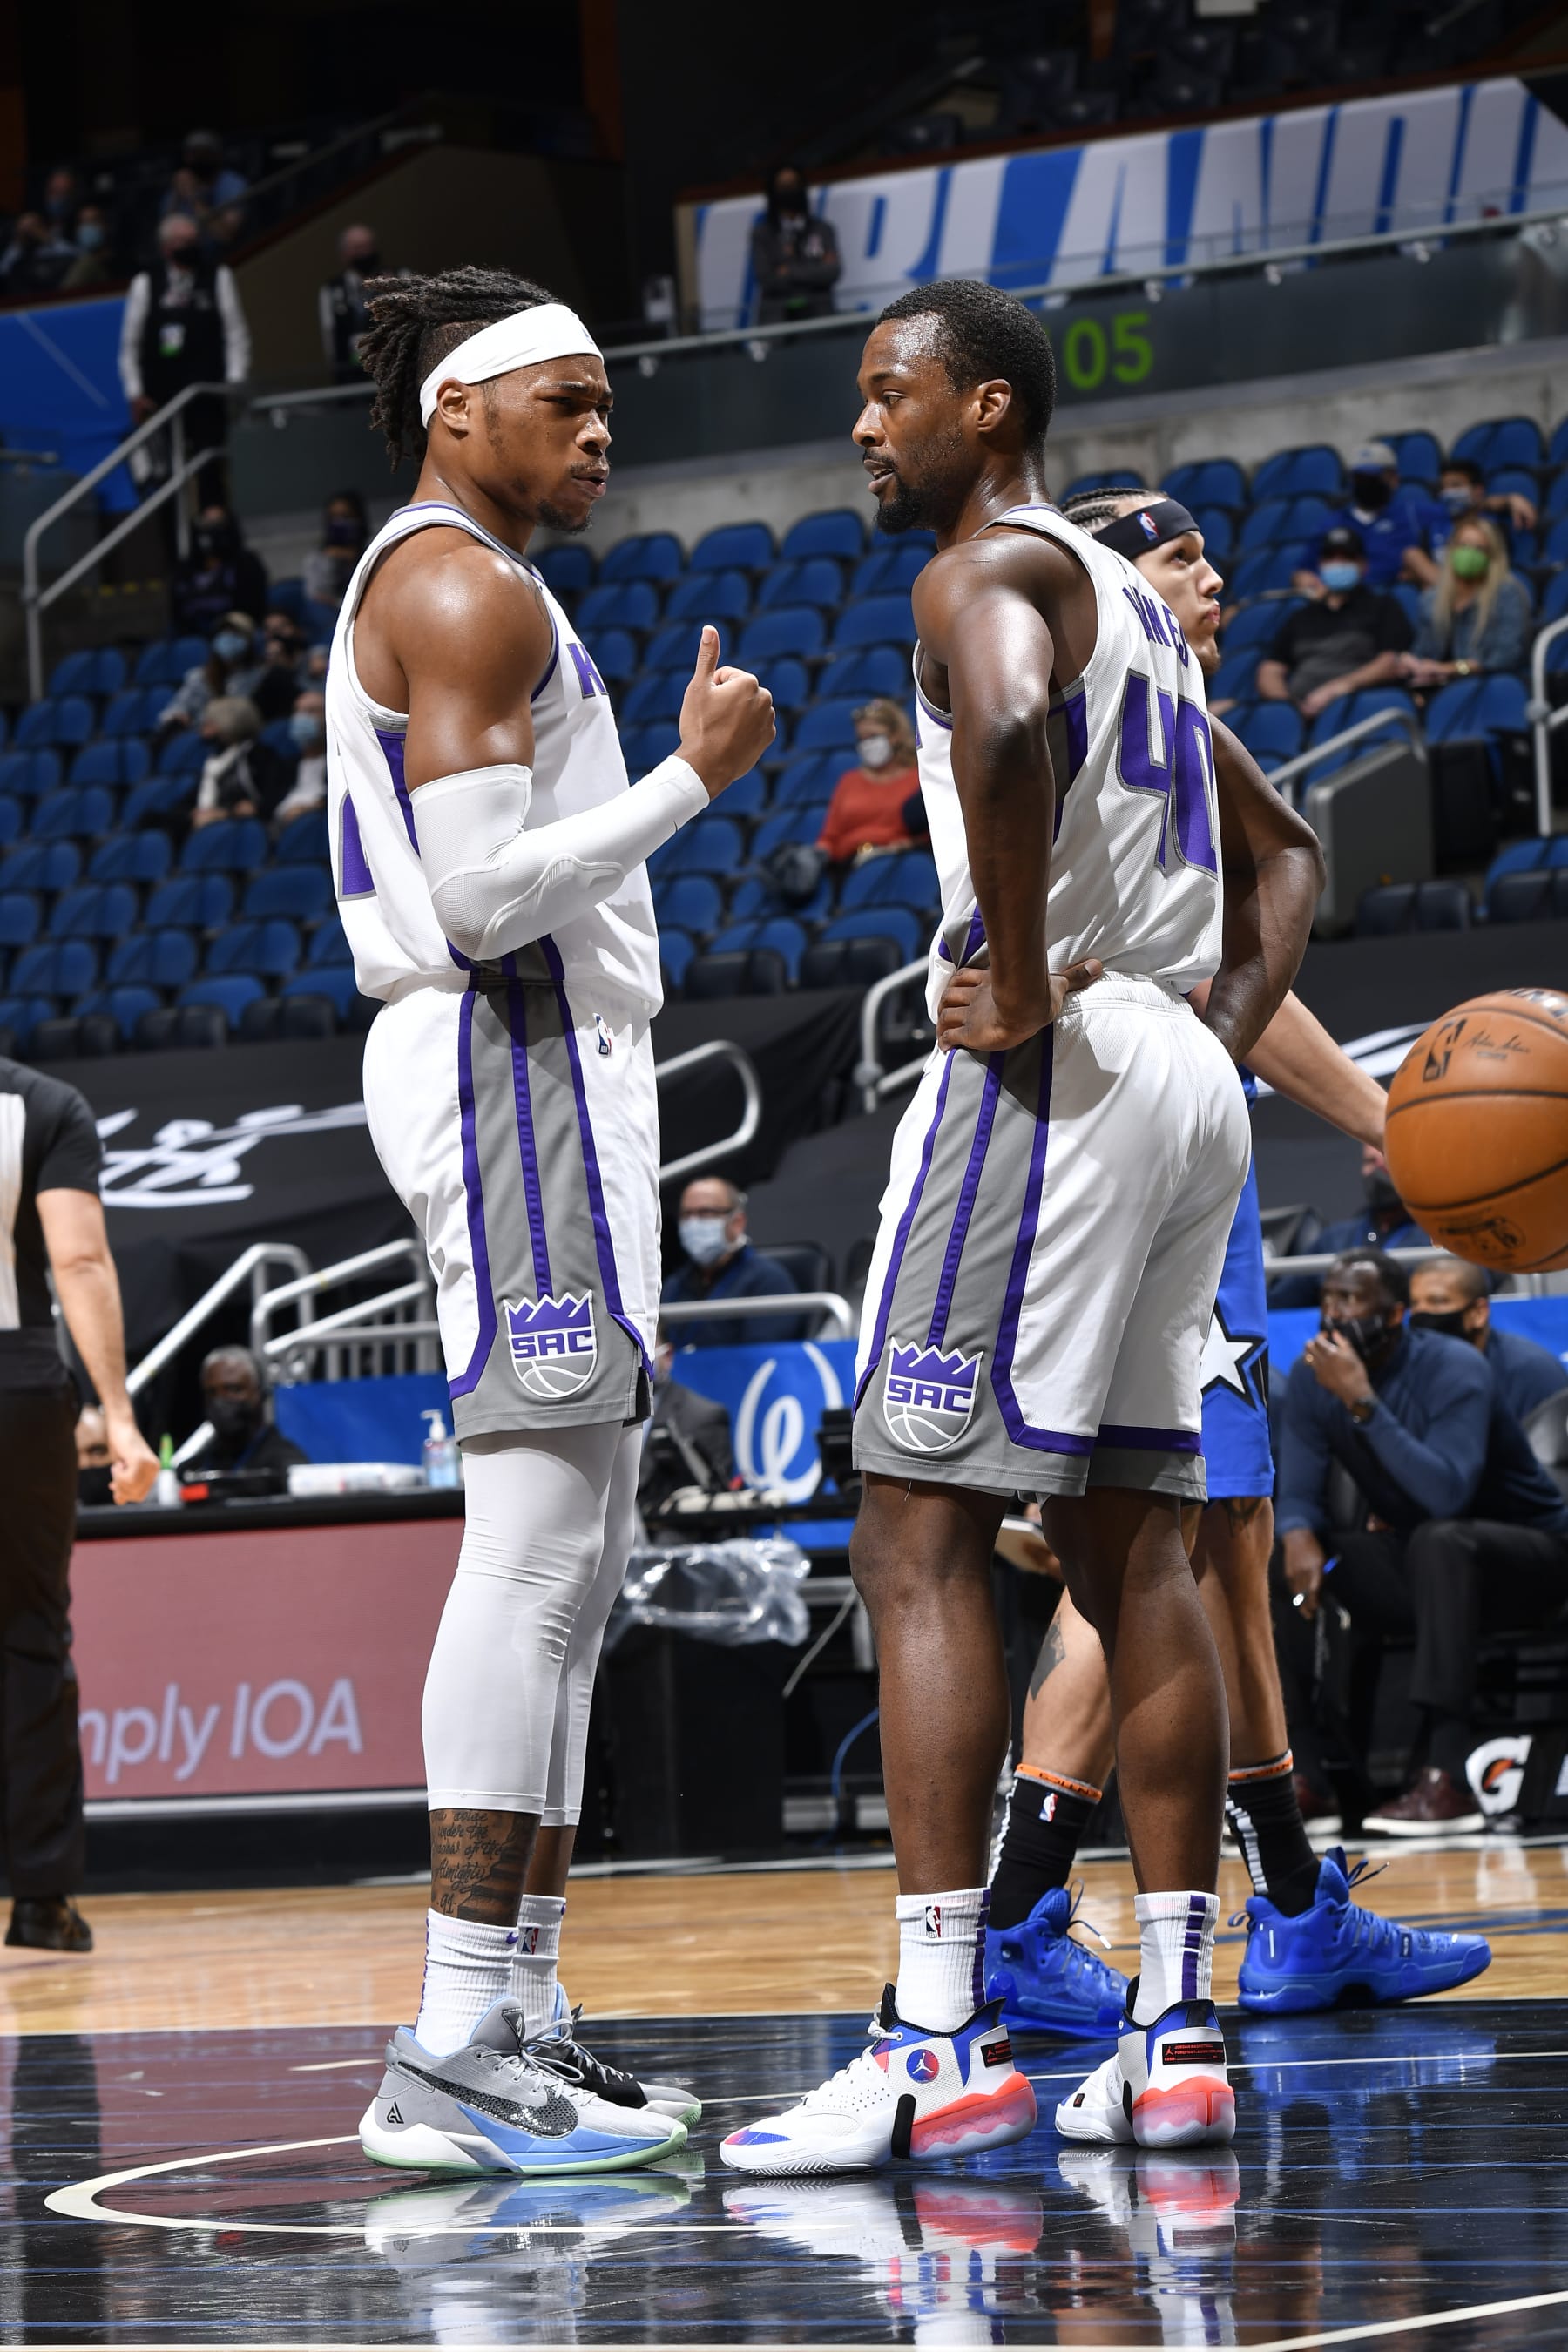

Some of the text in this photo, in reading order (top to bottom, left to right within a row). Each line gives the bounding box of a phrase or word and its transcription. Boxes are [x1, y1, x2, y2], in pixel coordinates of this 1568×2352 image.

[1064, 313, 1153, 389] 05
[1117, 668, 1220, 881] 40
[511, 1329, 594, 1359] SAC
[887, 1378, 972, 1413] SAC
[230, 1678, 362, 1759] IOA
